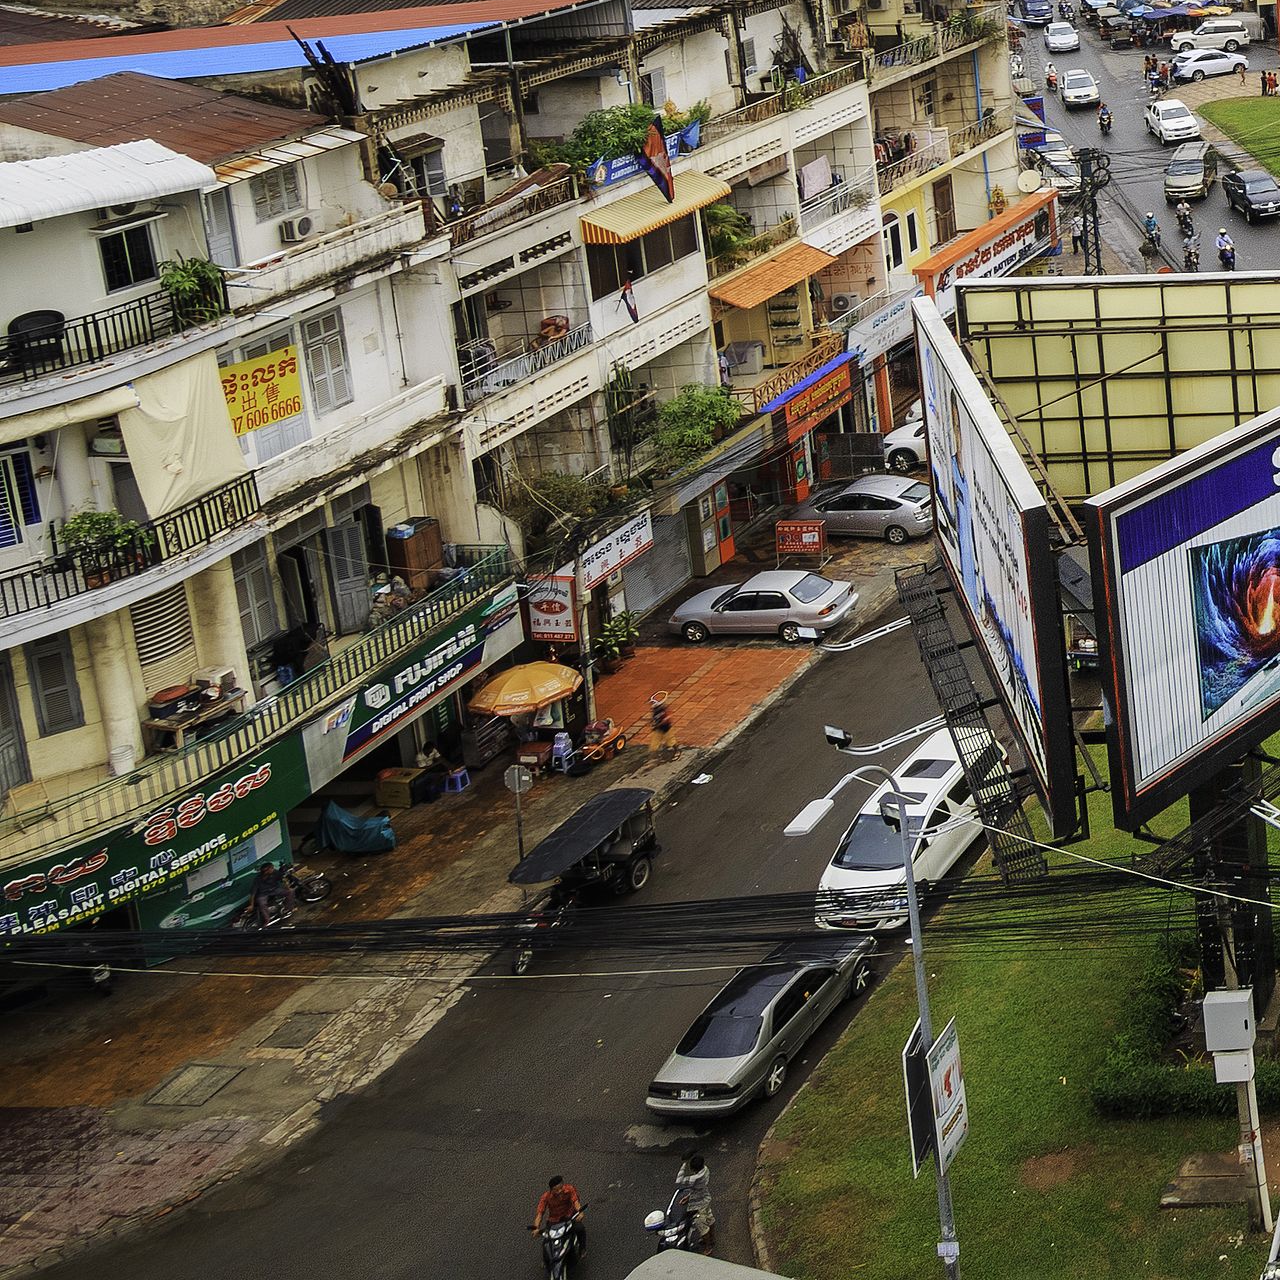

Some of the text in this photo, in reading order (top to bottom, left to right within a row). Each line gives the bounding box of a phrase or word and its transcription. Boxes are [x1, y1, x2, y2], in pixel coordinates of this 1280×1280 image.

[993, 255, 1017, 274] BATTERY
[246, 406, 269, 430] 606
[271, 395, 301, 421] 6666
[393, 623, 477, 695] FUJIFILM
[371, 704, 409, 735] DIGITAL
[408, 681, 438, 708] PRINT
[437, 662, 464, 689] SHOP
[11, 893, 105, 936] PLEASANT
[108, 867, 168, 901] DIGITAL
[170, 833, 228, 871] SERVICE
[65, 903, 106, 926] PENH
